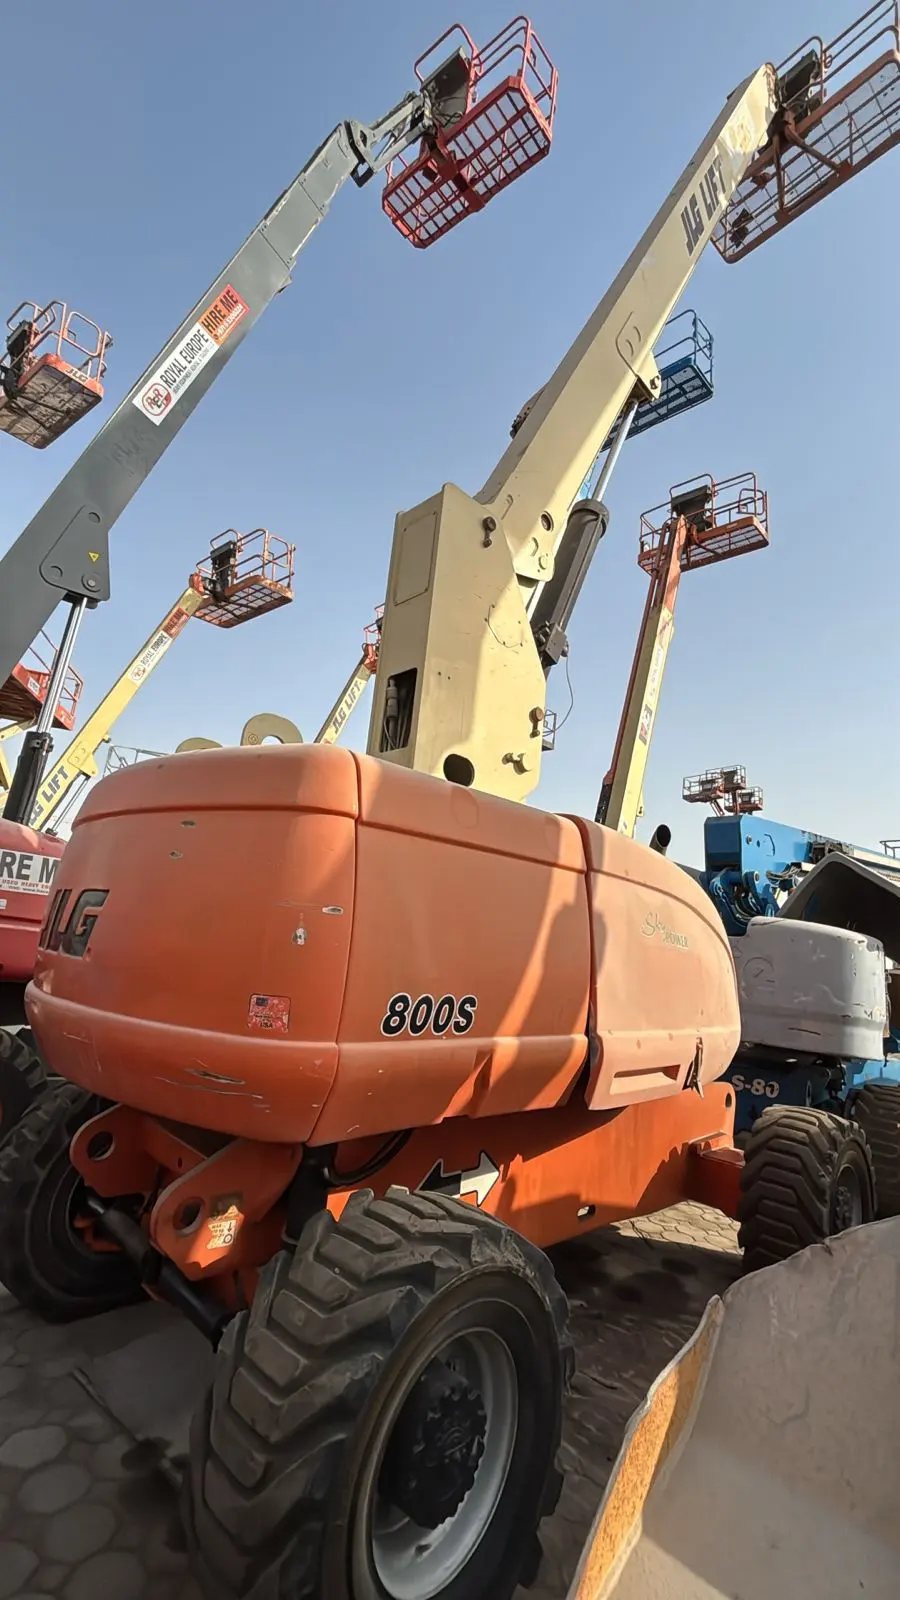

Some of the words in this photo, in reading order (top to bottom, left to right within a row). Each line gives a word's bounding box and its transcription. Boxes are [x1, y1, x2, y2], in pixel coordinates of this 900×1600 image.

[681, 192, 704, 256] JLG
[699, 154, 726, 221] LIFT
[201, 304, 226, 334] HIRE
[220, 289, 238, 312] ME
[65, 368, 88, 382] JLG
[160, 358, 187, 388] ROYAL
[179, 329, 209, 364] EUROPE
[140, 650, 155, 666] ROYAL
[150, 632, 167, 652] EUROPE
[331, 707, 347, 735] JLG
[344, 680, 361, 709] LIFT
[42, 765, 68, 803] LIFT
[38, 888, 110, 958] JLG
[380, 992, 477, 1036] 800S
[731, 1074, 780, 1098] S-80
